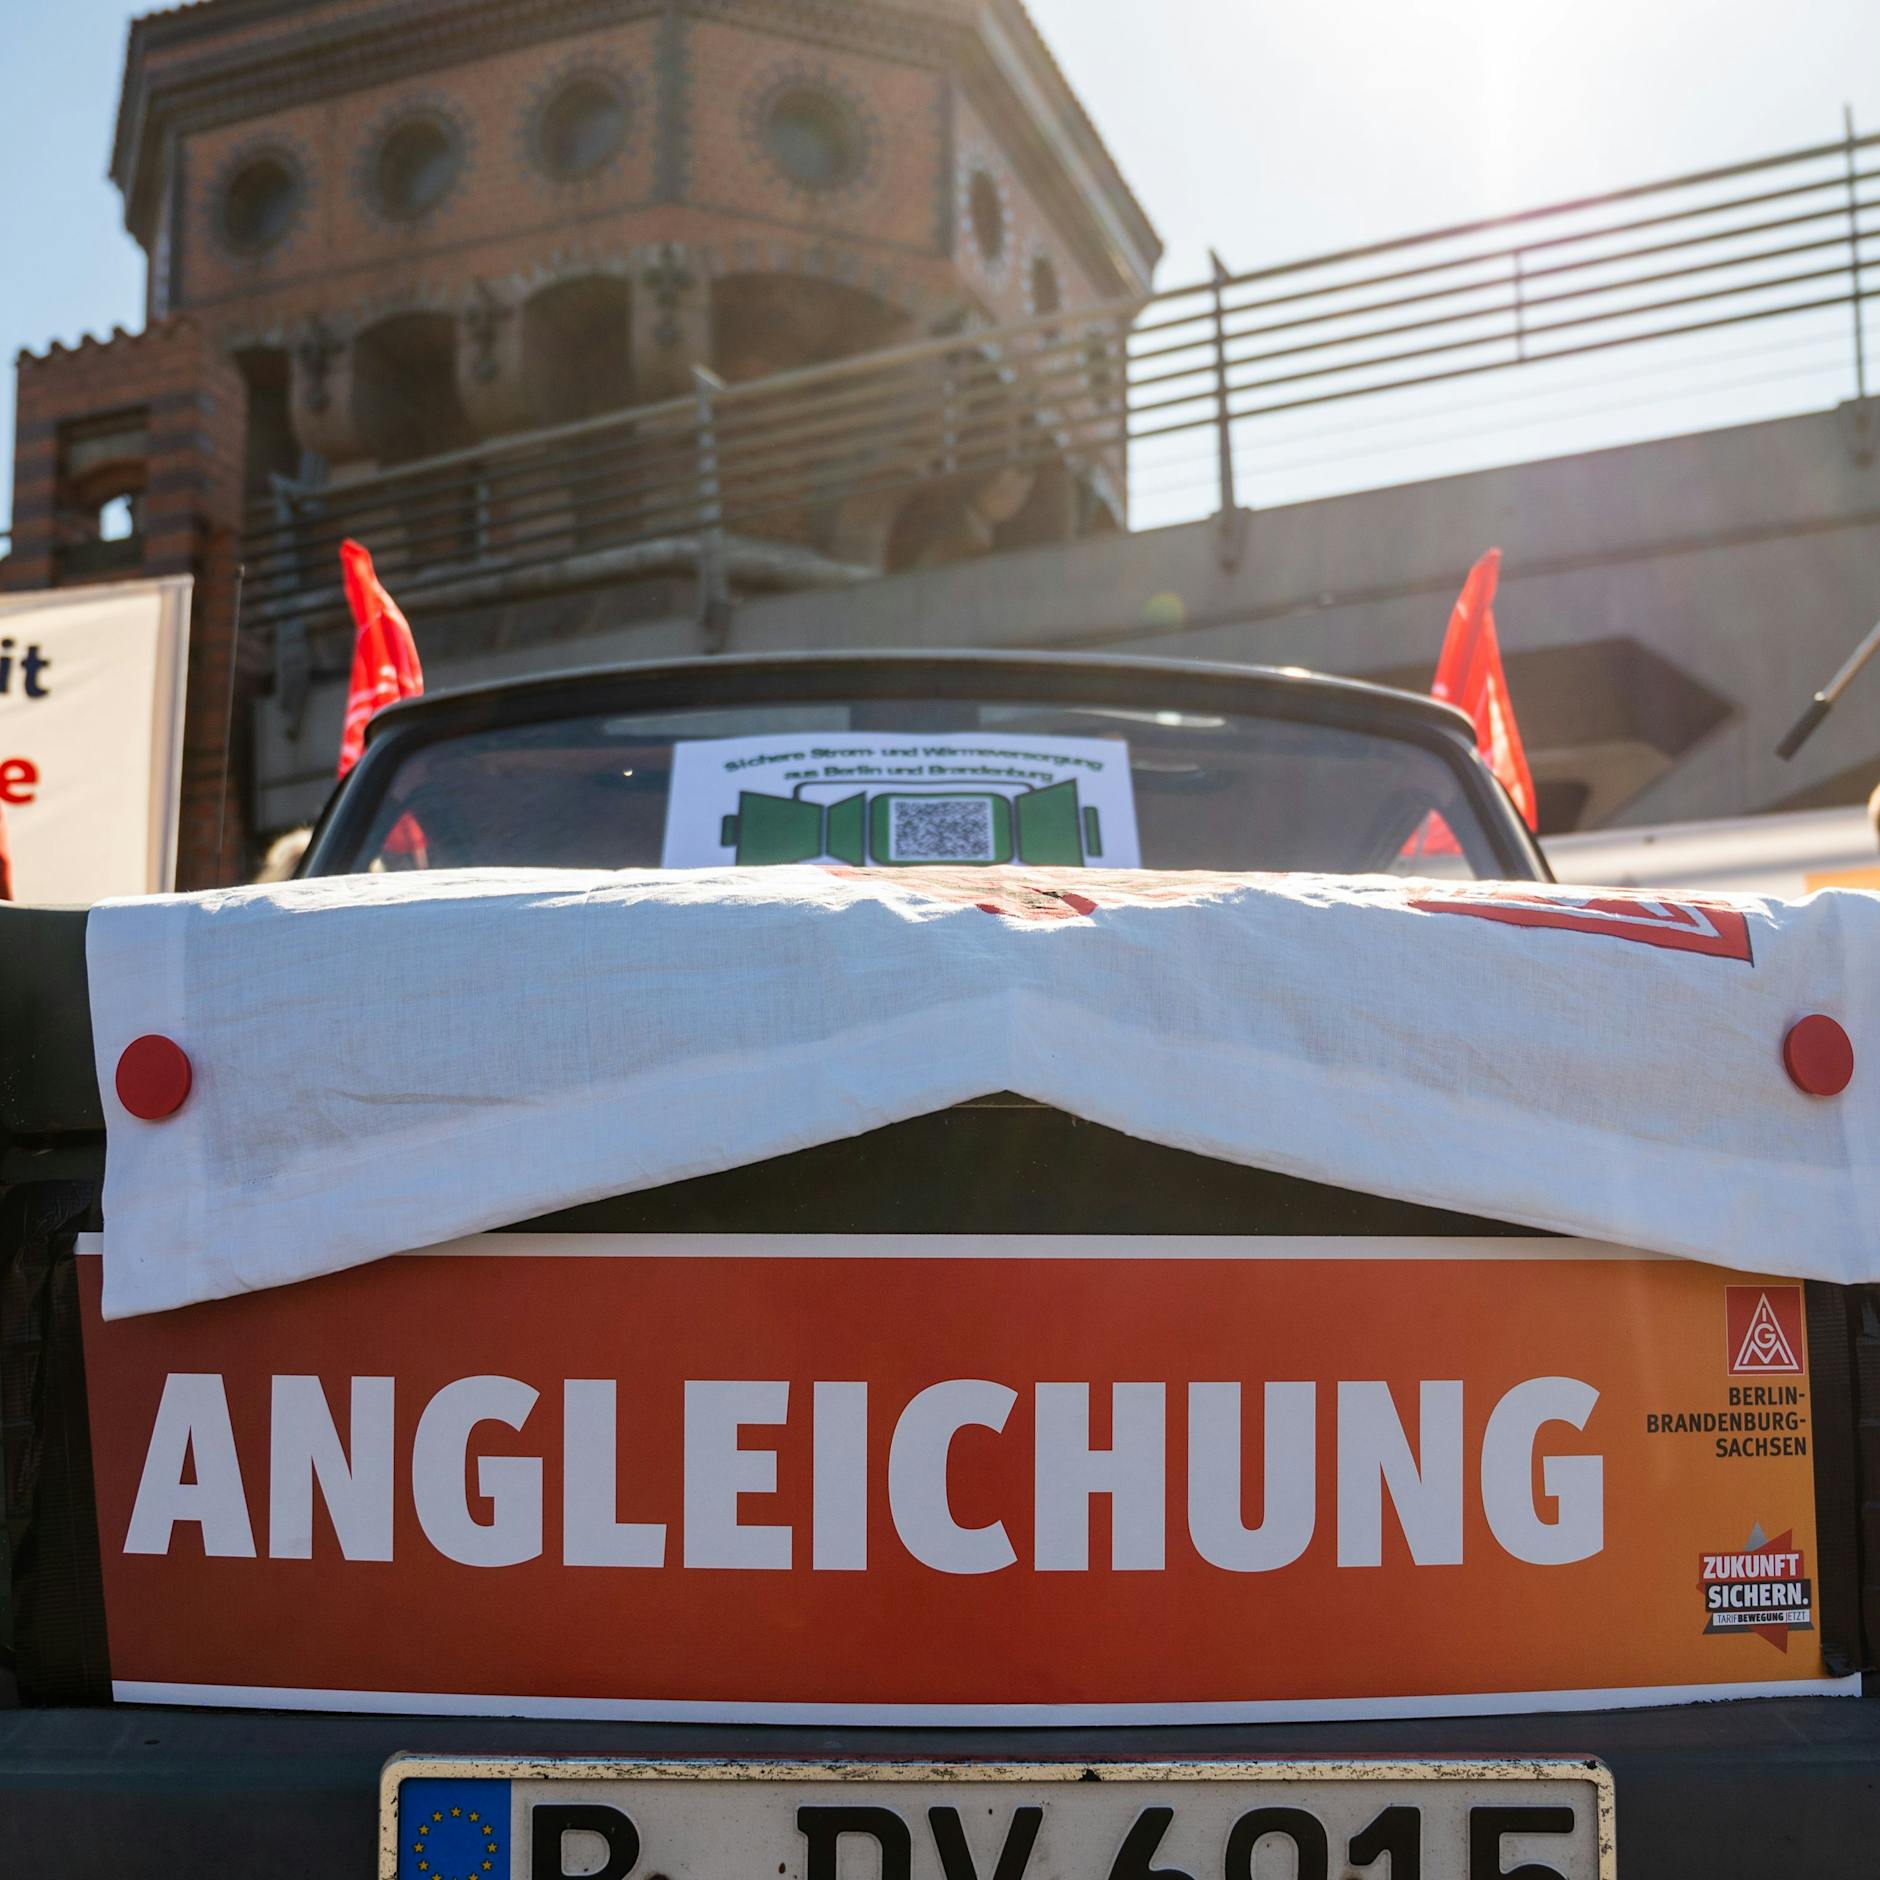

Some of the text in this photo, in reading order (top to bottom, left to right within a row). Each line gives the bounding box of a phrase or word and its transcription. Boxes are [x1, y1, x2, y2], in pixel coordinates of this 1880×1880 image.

[724, 752, 805, 771] Sichere
[811, 748, 874, 757] Strom-
[881, 748, 918, 757] und
[785, 765, 1053, 782] aus Berlin und Brandenburg
[1729, 1386, 1805, 1406] BERLIN-
[1646, 1412, 1806, 1433] BRANDENBURG-
[1715, 1437, 1806, 1458] SACHSEN
[123, 1372, 1605, 1575] ANGLEICHUNG
[1703, 1553, 1799, 1579] ZUKUNFT
[1708, 1583, 1809, 1608] SICHERN.
[1717, 1610, 1806, 1623] TARIFBEWEGUNG JETZT
